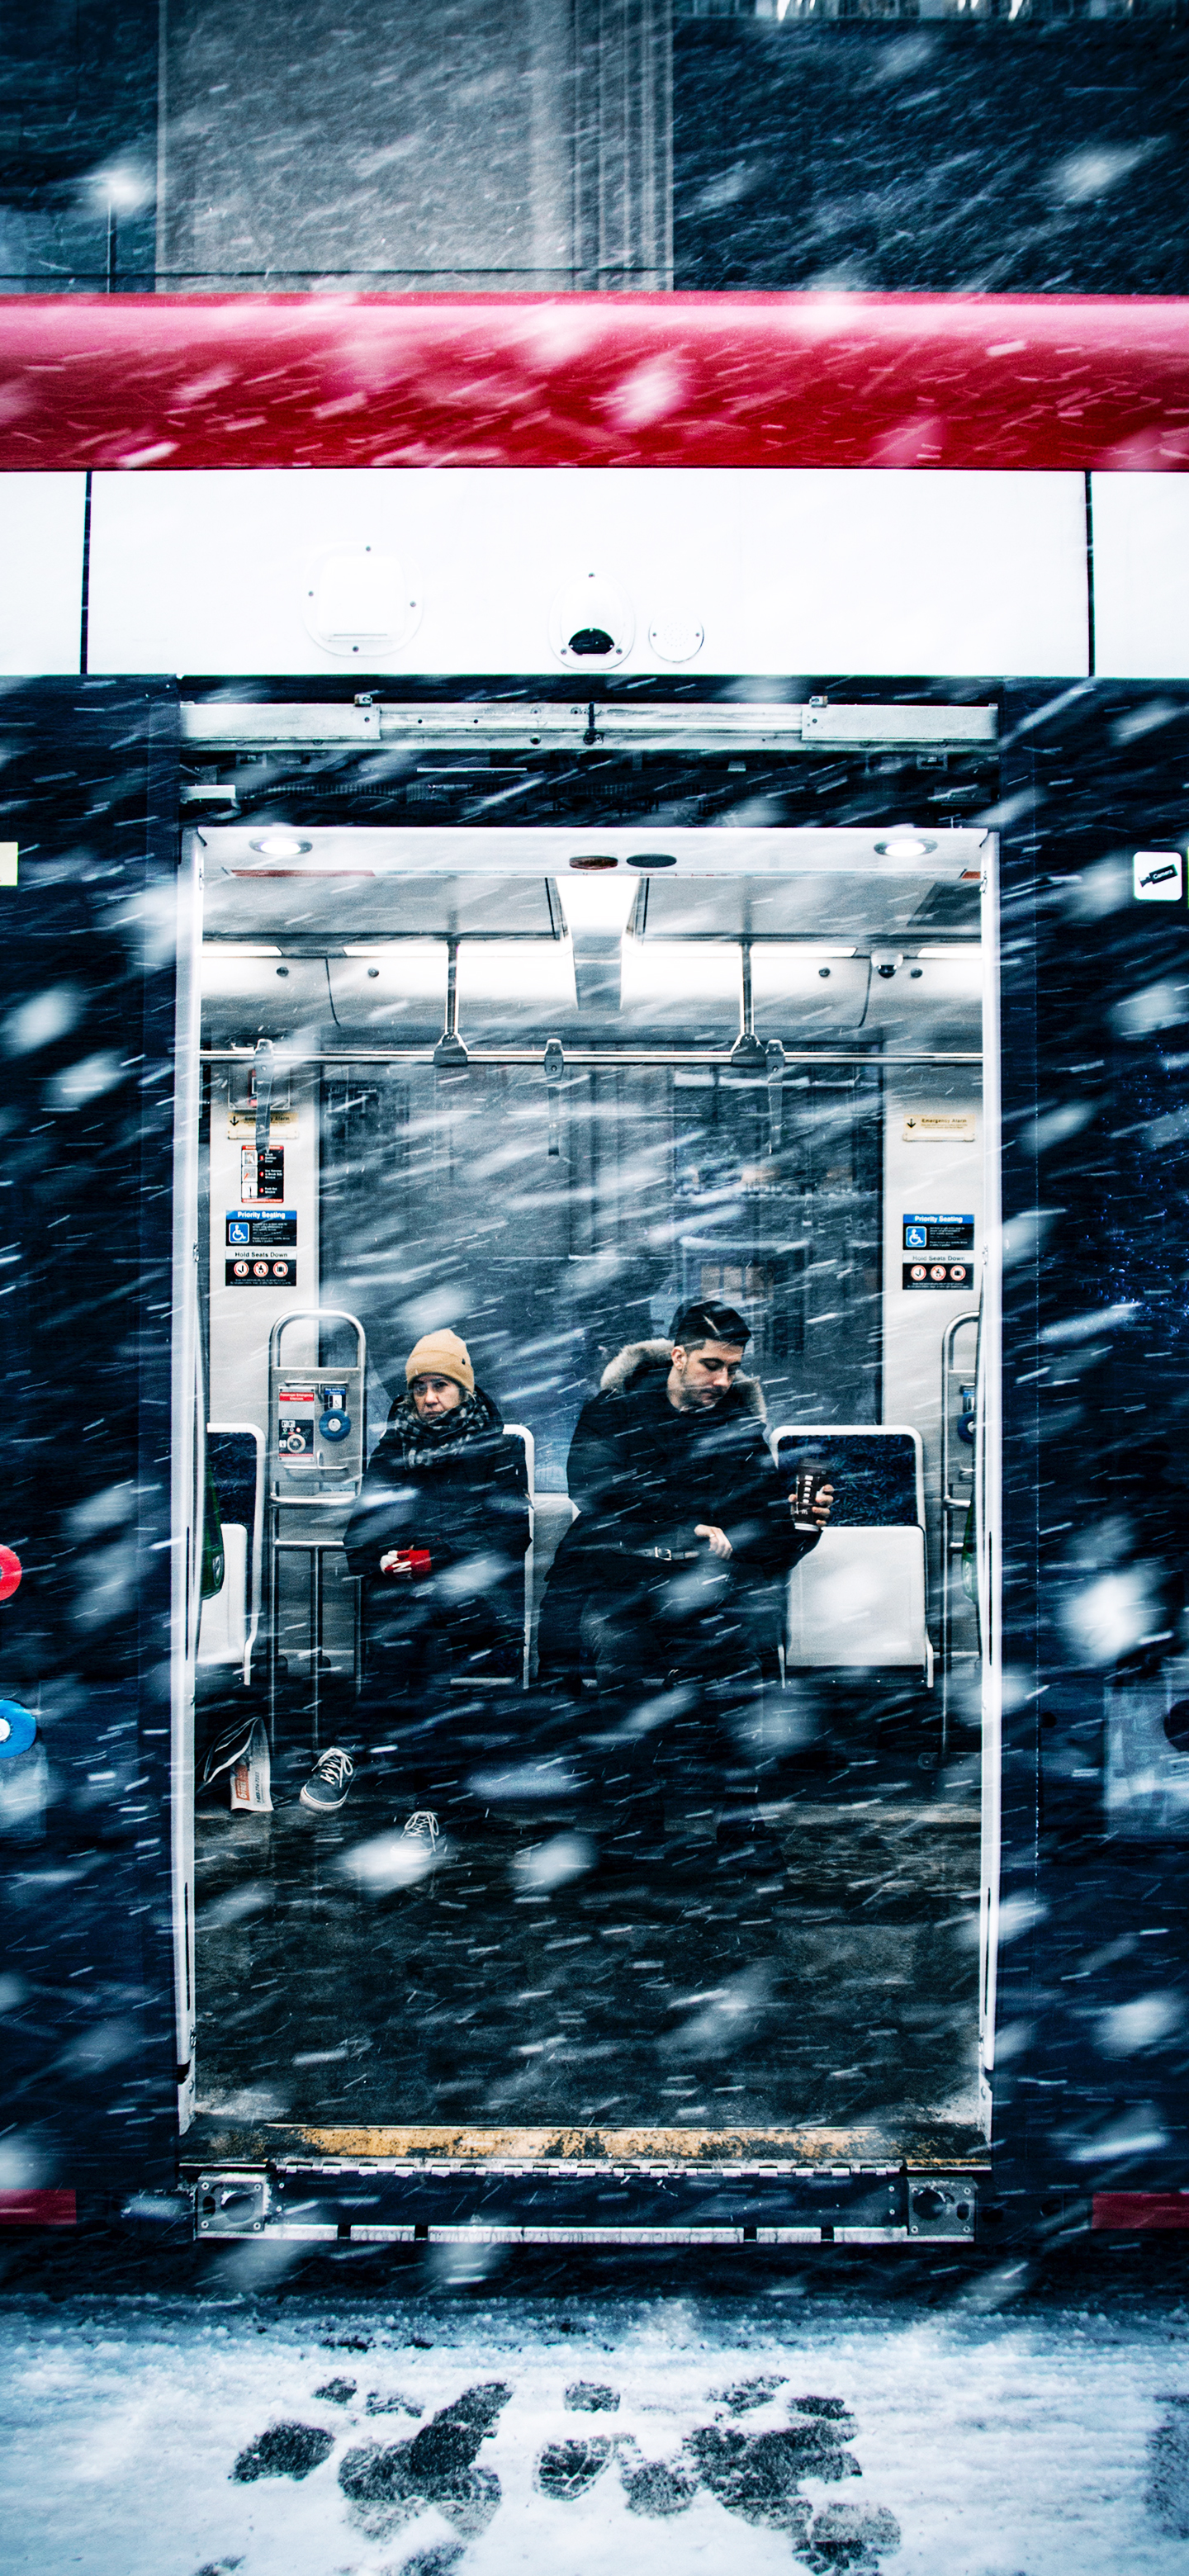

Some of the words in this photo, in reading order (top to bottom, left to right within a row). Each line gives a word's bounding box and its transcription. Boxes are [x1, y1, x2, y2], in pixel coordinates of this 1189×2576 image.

[237, 1211, 260, 1219] Priority
[262, 1211, 286, 1219] Seating
[914, 1215, 938, 1224] Priority
[939, 1215, 964, 1224] Seating
